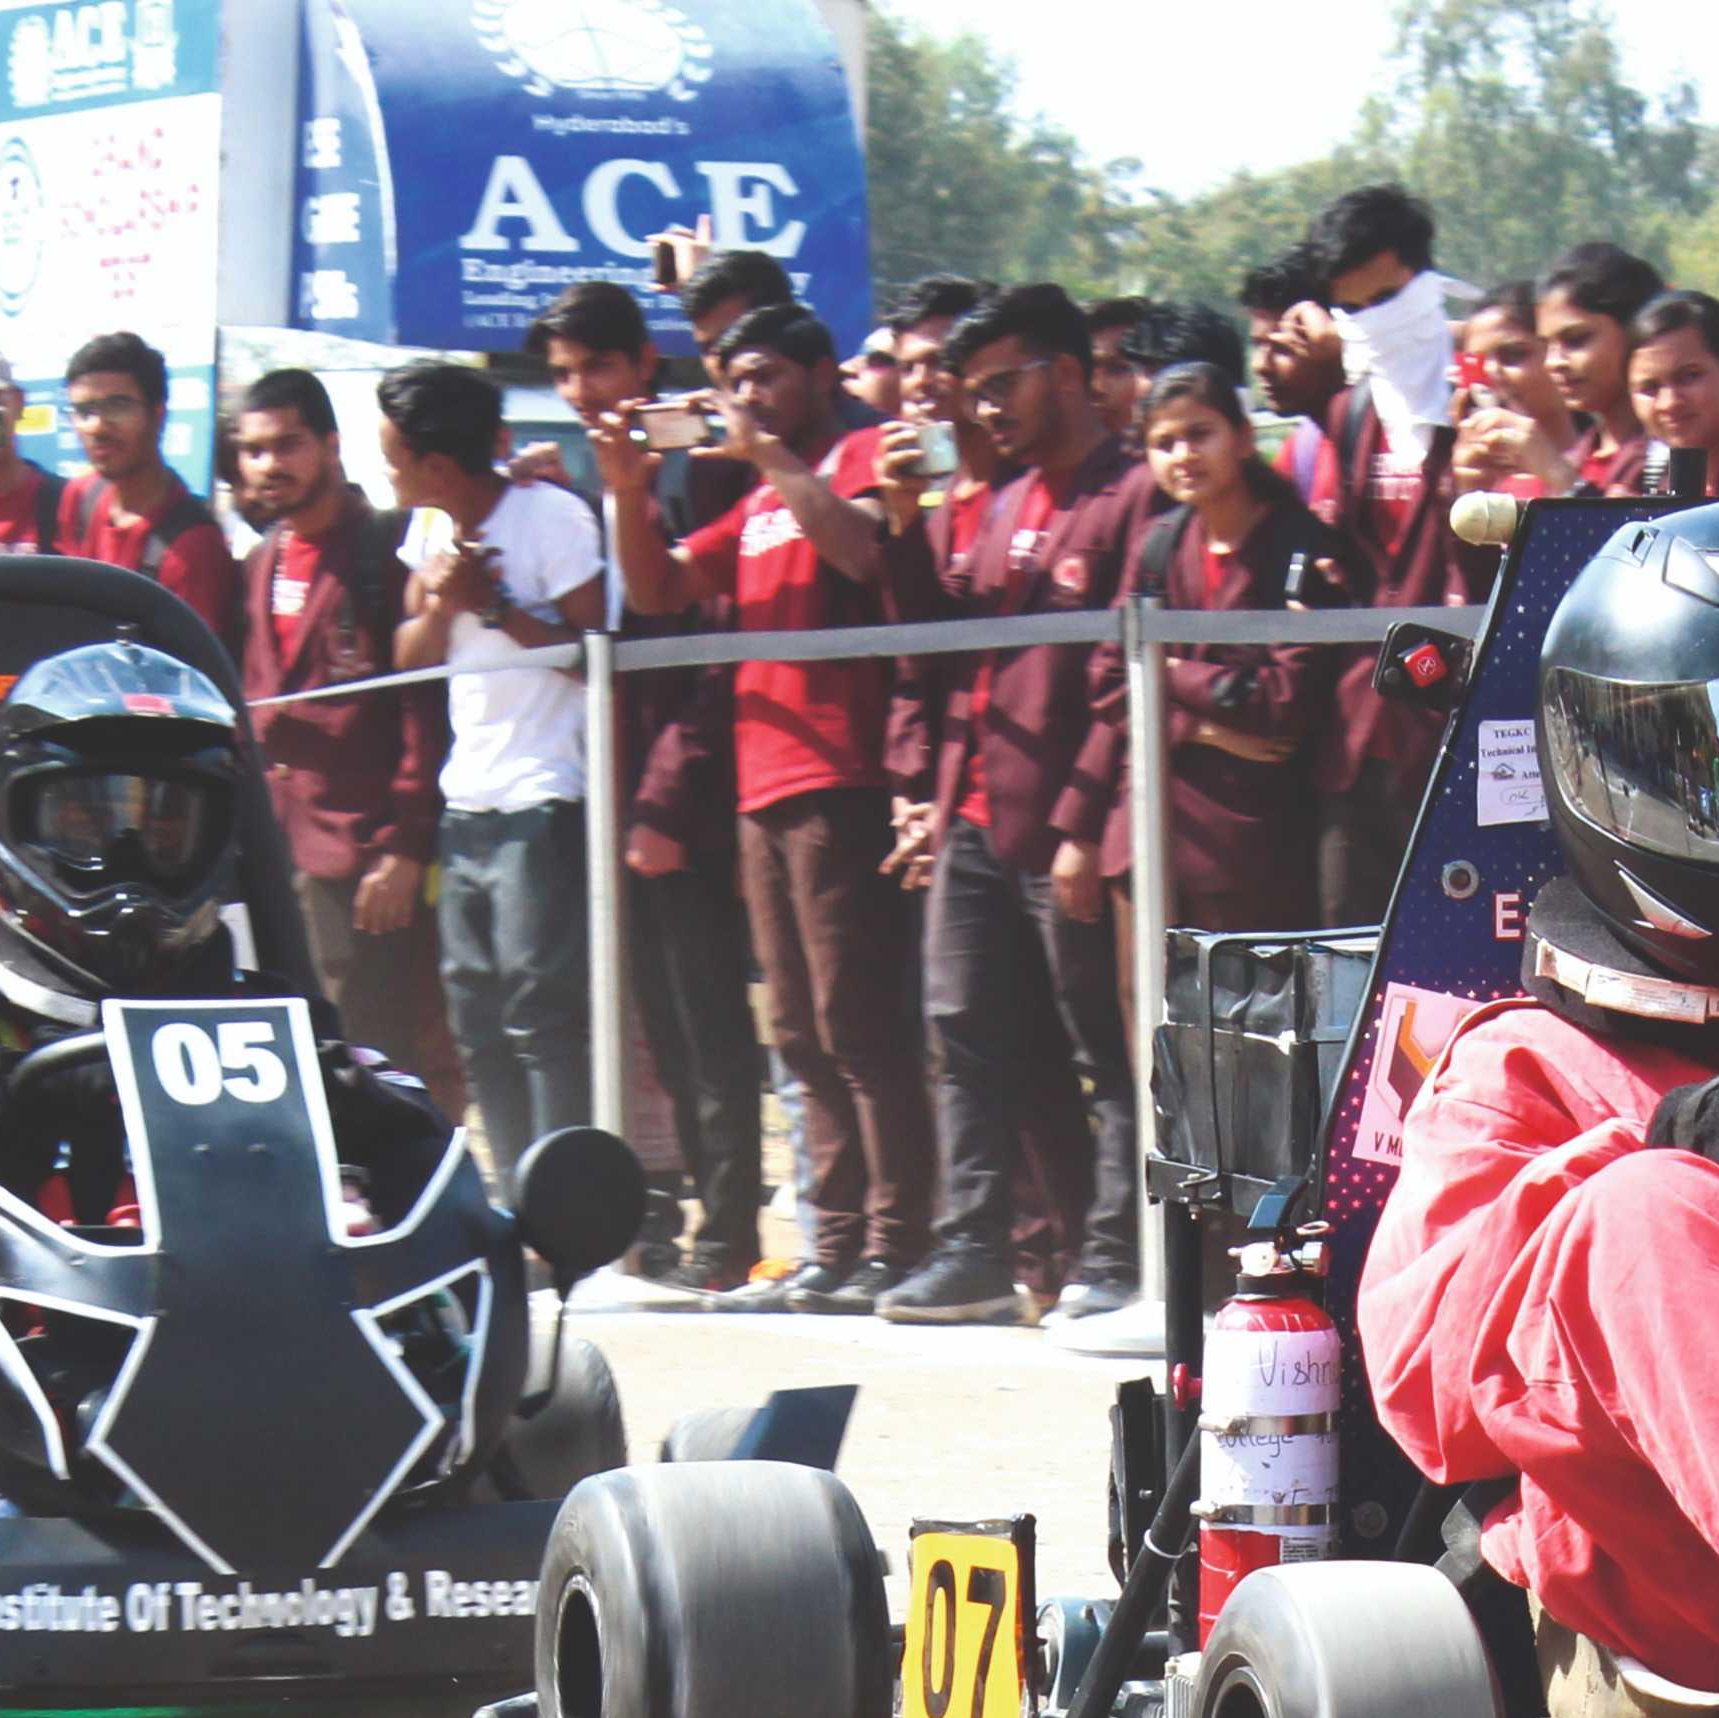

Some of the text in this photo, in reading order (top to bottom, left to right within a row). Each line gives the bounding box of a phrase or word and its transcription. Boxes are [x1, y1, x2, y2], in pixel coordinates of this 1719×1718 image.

[458, 154, 808, 260] ACE
[1480, 745, 1526, 759] Technical
[151, 1020, 289, 1106] 05
[125, 1582, 172, 1633] Of
[174, 1577, 379, 1637] Technology
[385, 1570, 416, 1621] &
